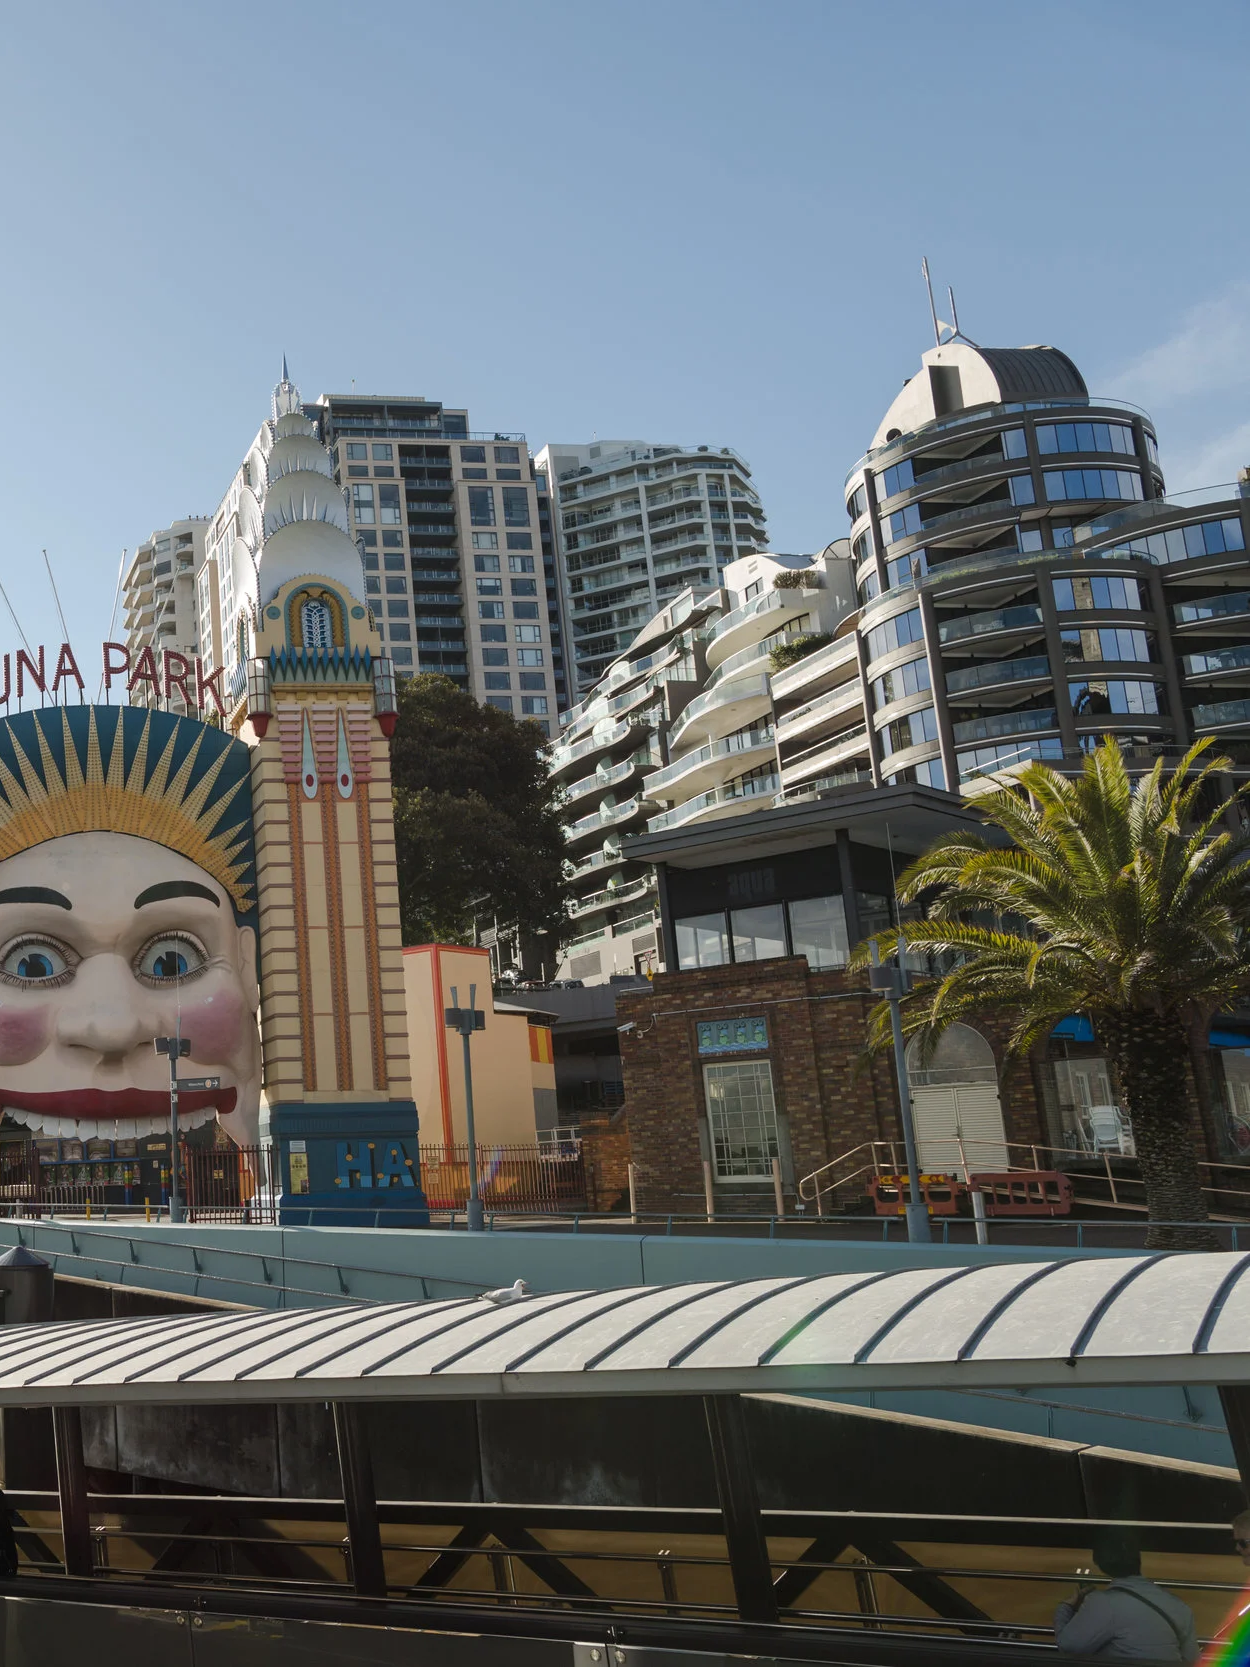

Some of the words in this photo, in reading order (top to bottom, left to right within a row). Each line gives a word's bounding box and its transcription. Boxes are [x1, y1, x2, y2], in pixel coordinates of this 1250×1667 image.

[103, 642, 227, 718] PARK
[728, 867, 775, 901] aqua
[336, 1141, 416, 1189] HA
